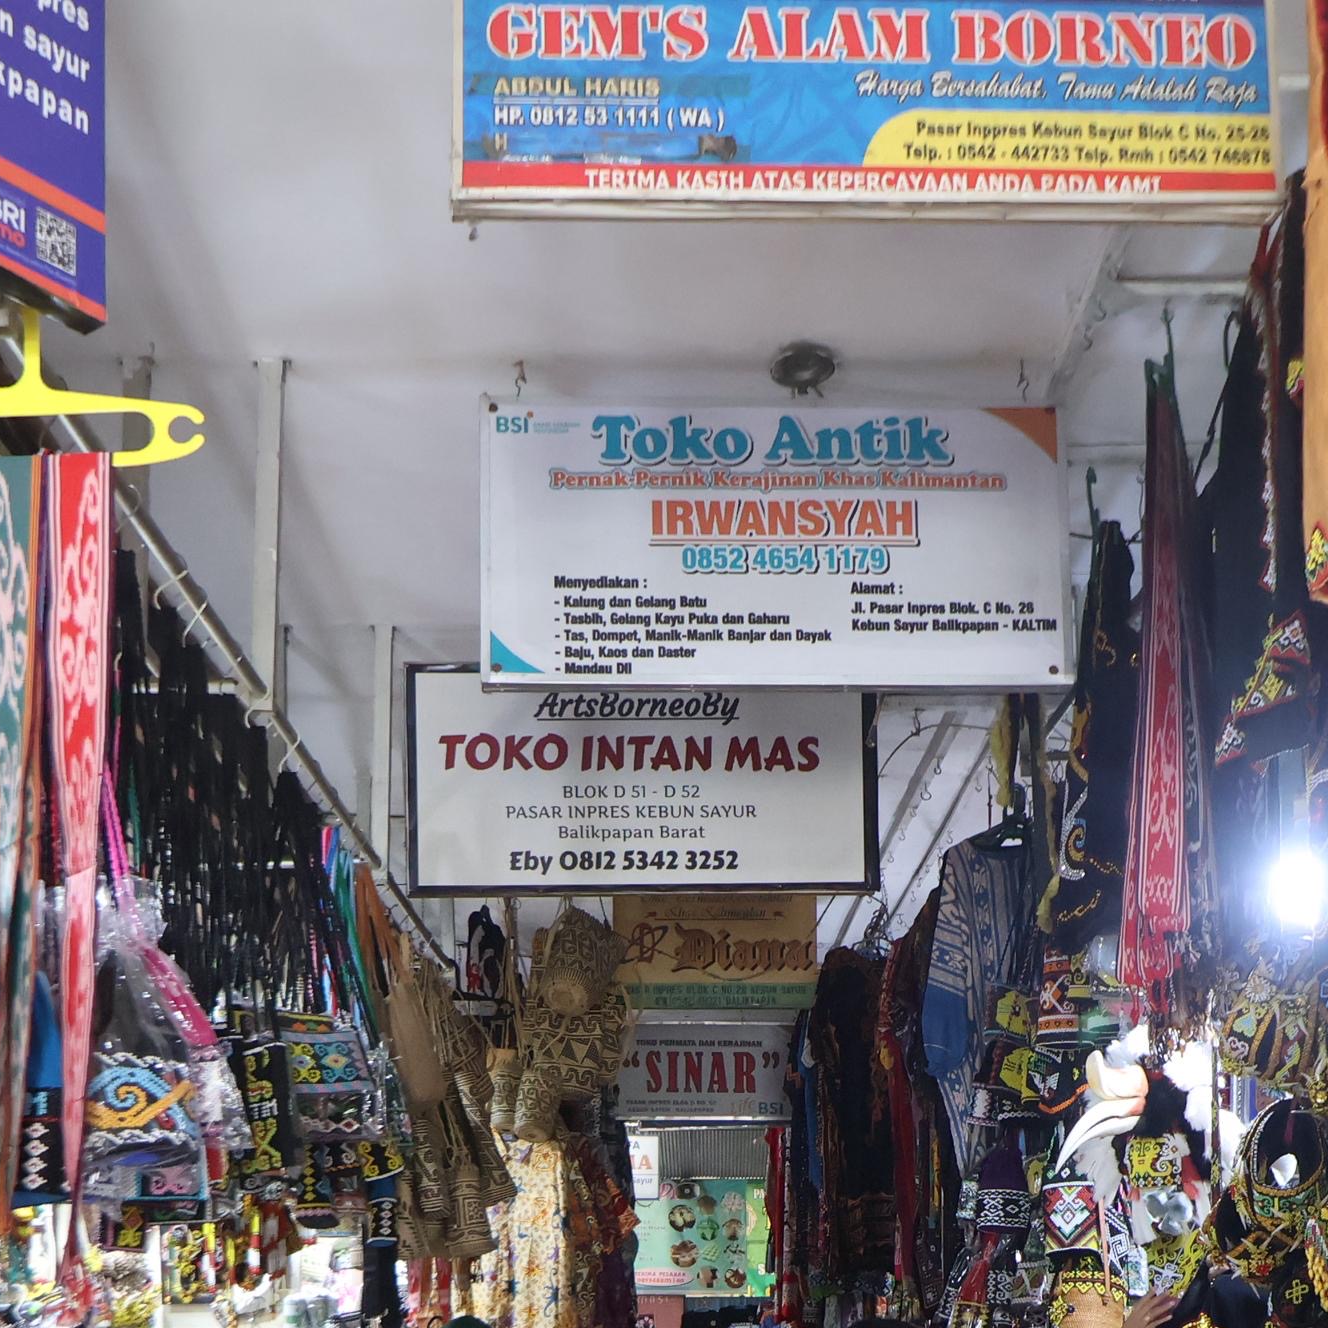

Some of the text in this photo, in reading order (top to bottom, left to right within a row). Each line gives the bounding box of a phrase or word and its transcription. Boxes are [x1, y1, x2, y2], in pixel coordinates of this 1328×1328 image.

[486, 6, 1257, 70] GEM'S ALAM BORNEO
[23, 24, 90, 82] sayur
[494, 77, 660, 97] ABDUL HARIS
[854, 69, 1258, 111] Harga Bersahabat, Tamu Adalah Raja
[494, 105, 524, 126] HP.
[679, 107, 713, 127] WA
[584, 168, 1162, 193] TERIMA KASIH ATAS KEPERCAYAAN ANDA PADA KAMI
[496, 415, 529, 433] BSI
[592, 415, 953, 465] Toko Antik
[551, 469, 1004, 492] Pernak-Pernik Kerajinan Khas Kalimantan
[651, 500, 915, 536] IRWANSYAH
[682, 547, 888, 571] 0852 4654 1179
[554, 576, 639, 591] Menyediakan
[851, 582, 895, 594] Alamat
[564, 596, 707, 610] Kalung dan Gelang Batu
[851, 602, 866, 614] Jl.
[871, 602, 904, 614] Pasar
[907, 602, 945, 616] Inpres
[950, 602, 979, 614] Blok.
[983, 602, 991, 614] C
[995, 602, 1014, 614] No.
[564, 613, 790, 627] Tasbih, Gelang Kayu Puka dan Gaharu
[852, 619, 1057, 633] Kebun Sayur Balikpapan KALTIM
[564, 629, 832, 644] Tas, Dompet, Manik-Manik Banjar dan Dayak
[565, 646, 696, 660] Baju, Kaos dan Daster
[565, 663, 612, 674] Mandau
[534, 692, 740, 725] ArtsBorneoBy
[438, 732, 820, 772] TOKO INTAN MAS
[563, 785, 700, 799] BLOK D 51 D 52
[506, 805, 757, 819] PASAR INPRES KEBUN SAYUR
[559, 825, 706, 842] Balikpapan Barat
[510, 850, 739, 875] Eby 0812 5342 3252
[672, 922, 813, 972] Diana
[758, 1102, 784, 1115] BSI
